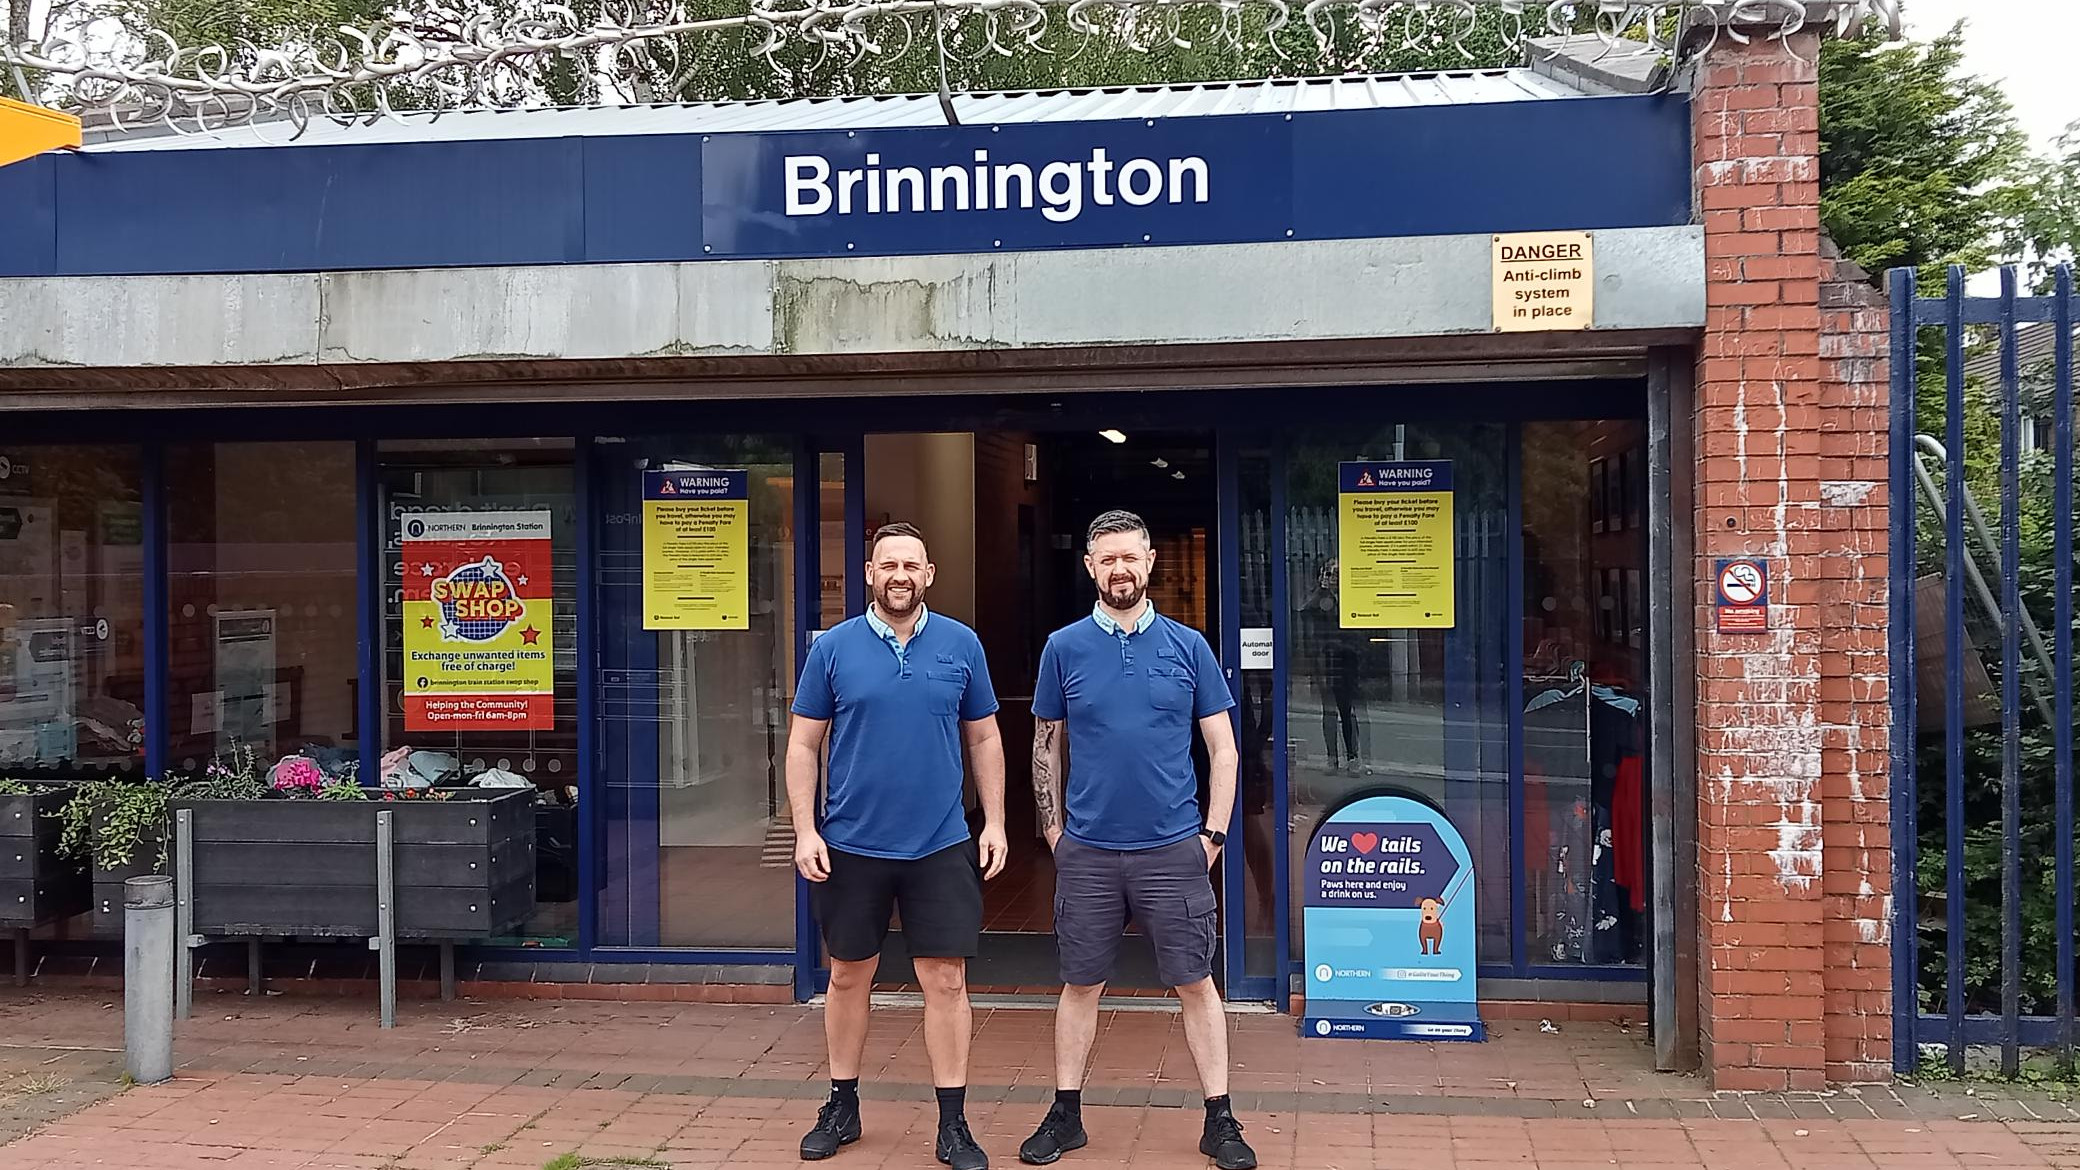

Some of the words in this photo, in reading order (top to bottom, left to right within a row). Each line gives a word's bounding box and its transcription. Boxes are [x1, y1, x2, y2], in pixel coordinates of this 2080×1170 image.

[784, 148, 1209, 222] Brinnington
[1501, 244, 1581, 260] DANGER
[1503, 267, 1582, 282] Anti-climb
[1515, 288, 1570, 303] system
[1513, 306, 1527, 317] in
[1532, 305, 1573, 319] place
[1378, 468, 1433, 479] WARNING
[679, 477, 730, 487] WARNING
[1411, 479, 1431, 487] paid?
[709, 487, 729, 495] paid?
[427, 523, 467, 533] NORTHERN
[471, 522, 516, 533] Brinnington
[516, 522, 544, 531] Station
[434, 580, 505, 600] SWAP
[455, 599, 522, 620] SHOP
[411, 651, 461, 662] Exchange
[463, 651, 514, 660] unwanted
[516, 650, 546, 660] items
[441, 661, 463, 671] free
[464, 661, 476, 671] of
[476, 661, 516, 673] charge!
[467, 678, 483, 686] train
[483, 678, 505, 686] station
[425, 700, 459, 711] Helping
[460, 700, 475, 709] the
[476, 700, 529, 711] Community!
[1320, 836, 1348, 853] We
[1381, 835, 1421, 853] tails
[1320, 860, 1342, 874] on
[1347, 857, 1376, 874] the
[1379, 857, 1426, 874] rails.
[1321, 879, 1344, 889] Paws
[1344, 880, 1364, 889] here
[1365, 880, 1381, 889] and
[1382, 880, 1407, 892] enjoy
[1320, 891, 1327, 899] a
[1328, 890, 1351, 899] drink
[1351, 891, 1363, 899] on
[1363, 891, 1377, 899] us.
[1335, 969, 1371, 978] NORTHERN
[1333, 1024, 1365, 1032] NORTHERN
